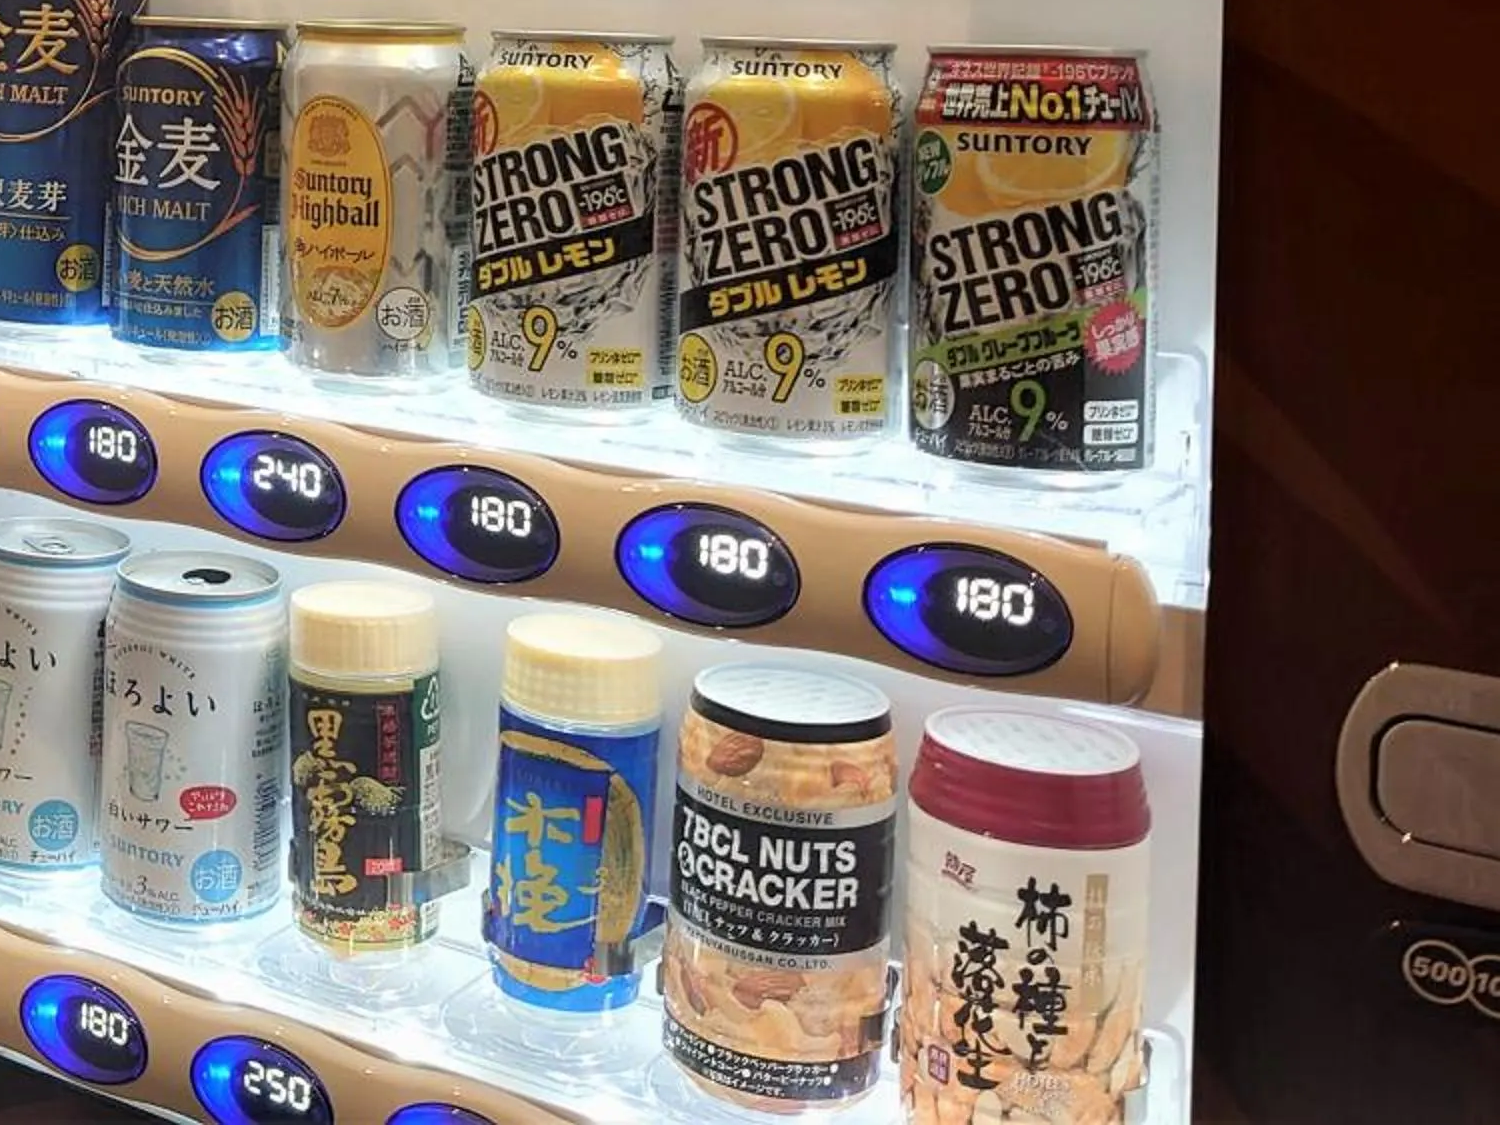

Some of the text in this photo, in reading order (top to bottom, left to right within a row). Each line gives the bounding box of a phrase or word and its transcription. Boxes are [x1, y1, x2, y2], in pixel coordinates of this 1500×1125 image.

[500, 50, 595, 69] SUNTORY
[732, 58, 843, 80] SUNTORY
[10, 84, 69, 106] MALT
[122, 87, 205, 108] SUNTORY
[115, 112, 222, 191] 金麦
[957, 133, 1093, 156] SUNTORY
[473, 125, 627, 206] STRONG
[694, 138, 878, 229] STRONG
[152, 200, 212, 222] MALT
[475, 188, 577, 252] ZERO
[701, 207, 829, 282] ZERO
[930, 192, 1123, 278] STRONG
[540, 237, 616, 275] レモン
[708, 258, 868, 317] ダブル レモン
[939, 260, 1071, 332] ZERO
[215, 305, 254, 331] お酒
[381, 303, 425, 328] お酒
[89, 427, 137, 462] 180
[254, 456, 321, 497] 240
[471, 497, 532, 537] 180
[700, 534, 769, 578] 180
[957, 578, 1033, 625] 180
[32, 813, 75, 840] お酒
[742, 802, 834, 825] EXCLUSIVE
[682, 805, 857, 874] TBCL NUTS
[196, 863, 240, 890] お酒
[710, 895, 753, 920] PEPPER
[757, 911, 821, 927] CRACKER
[1412, 956, 1467, 987] 500
[80, 1002, 129, 1046] 180
[243, 1061, 312, 1111] 250
